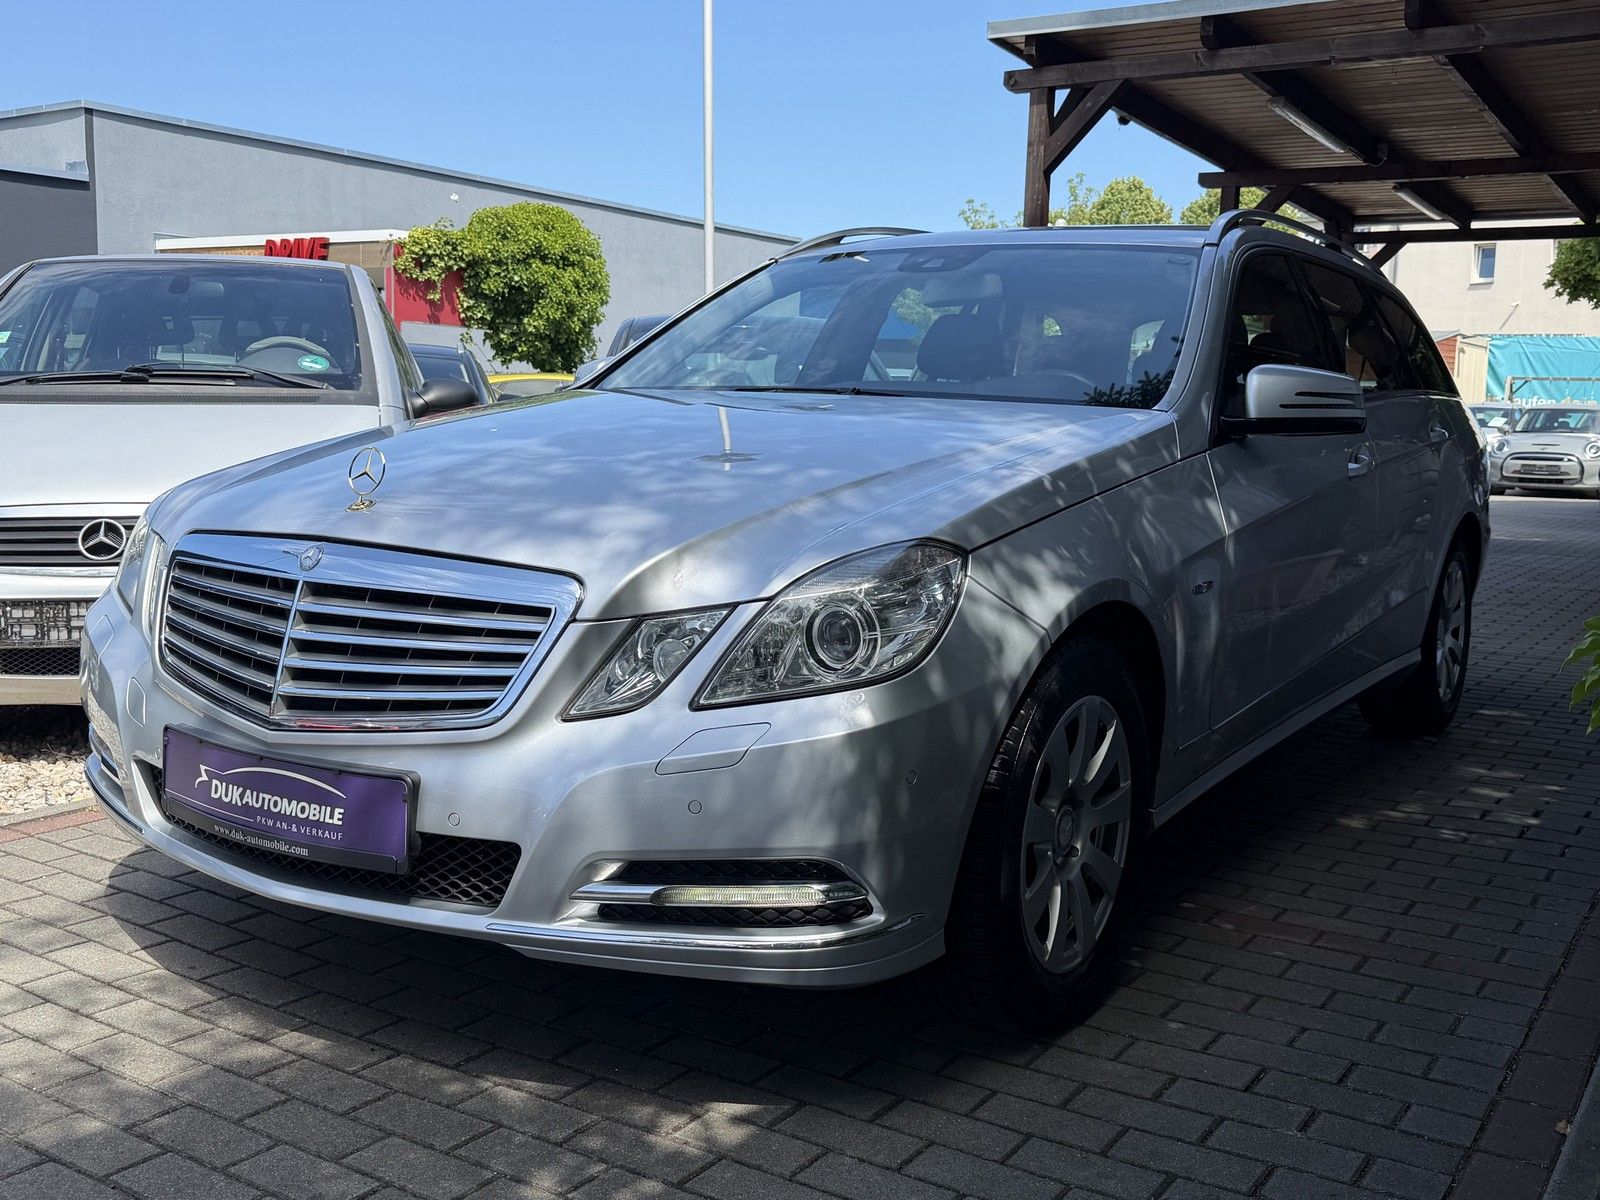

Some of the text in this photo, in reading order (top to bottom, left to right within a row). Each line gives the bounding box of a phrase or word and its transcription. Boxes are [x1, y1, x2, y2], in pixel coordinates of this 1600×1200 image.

[264, 237, 331, 261] DRIVE
[213, 825, 310, 857] www.duk-automobile.com
[256, 815, 275, 827] PKW
[300, 826, 344, 841] VERKAUF
